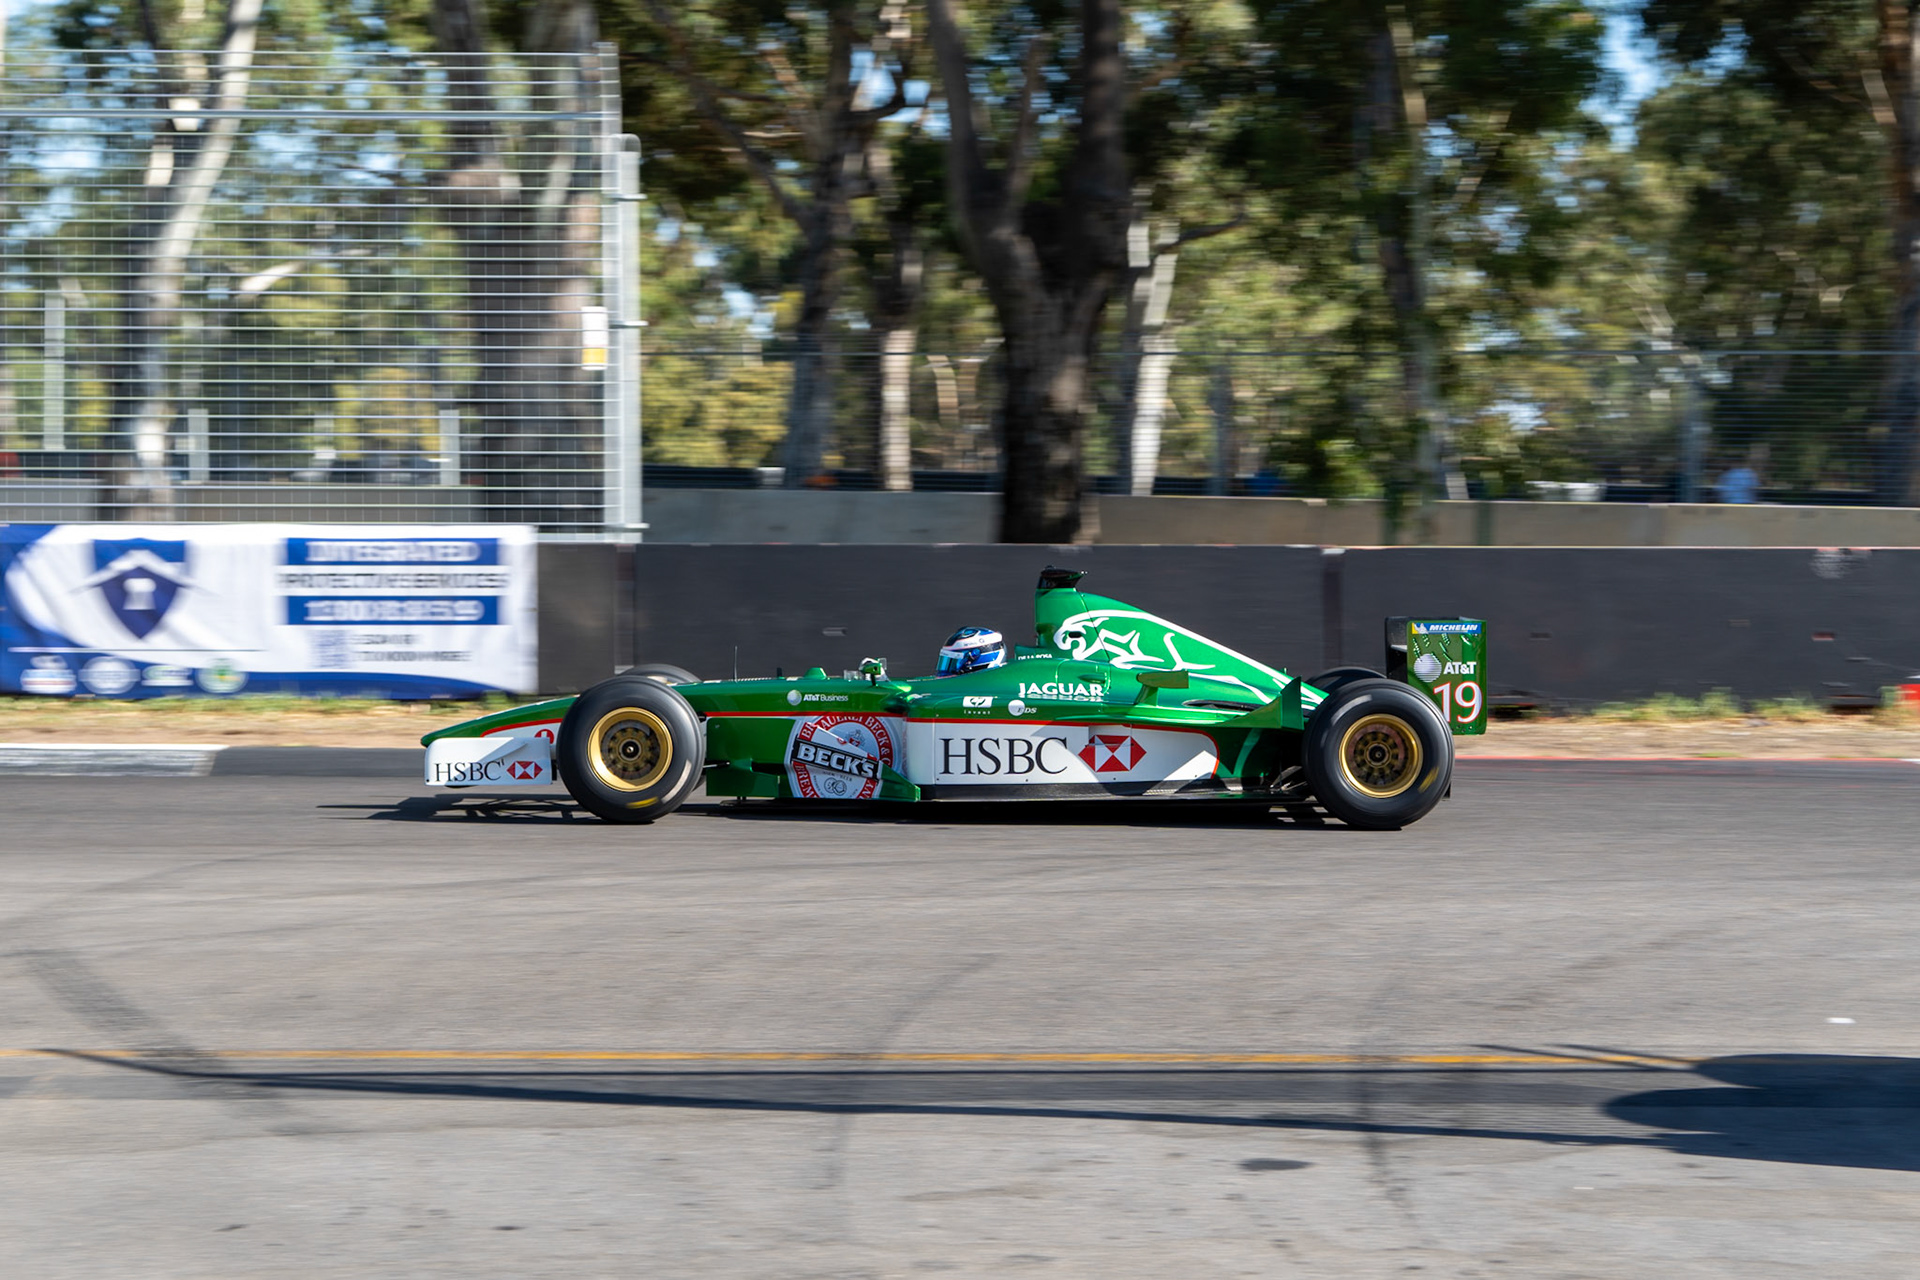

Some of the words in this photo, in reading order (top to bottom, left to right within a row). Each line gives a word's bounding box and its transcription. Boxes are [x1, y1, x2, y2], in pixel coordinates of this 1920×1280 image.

[1443, 661, 1477, 675] AT&T
[803, 693, 820, 702] AT&T
[820, 694, 849, 702] Business
[1018, 682, 1104, 698] JAGUAR
[1433, 681, 1483, 724] 19
[864, 716, 890, 746] BECK
[797, 742, 875, 778] BECK'S
[939, 736, 1068, 775] HSBC
[433, 758, 505, 782] HSBC
